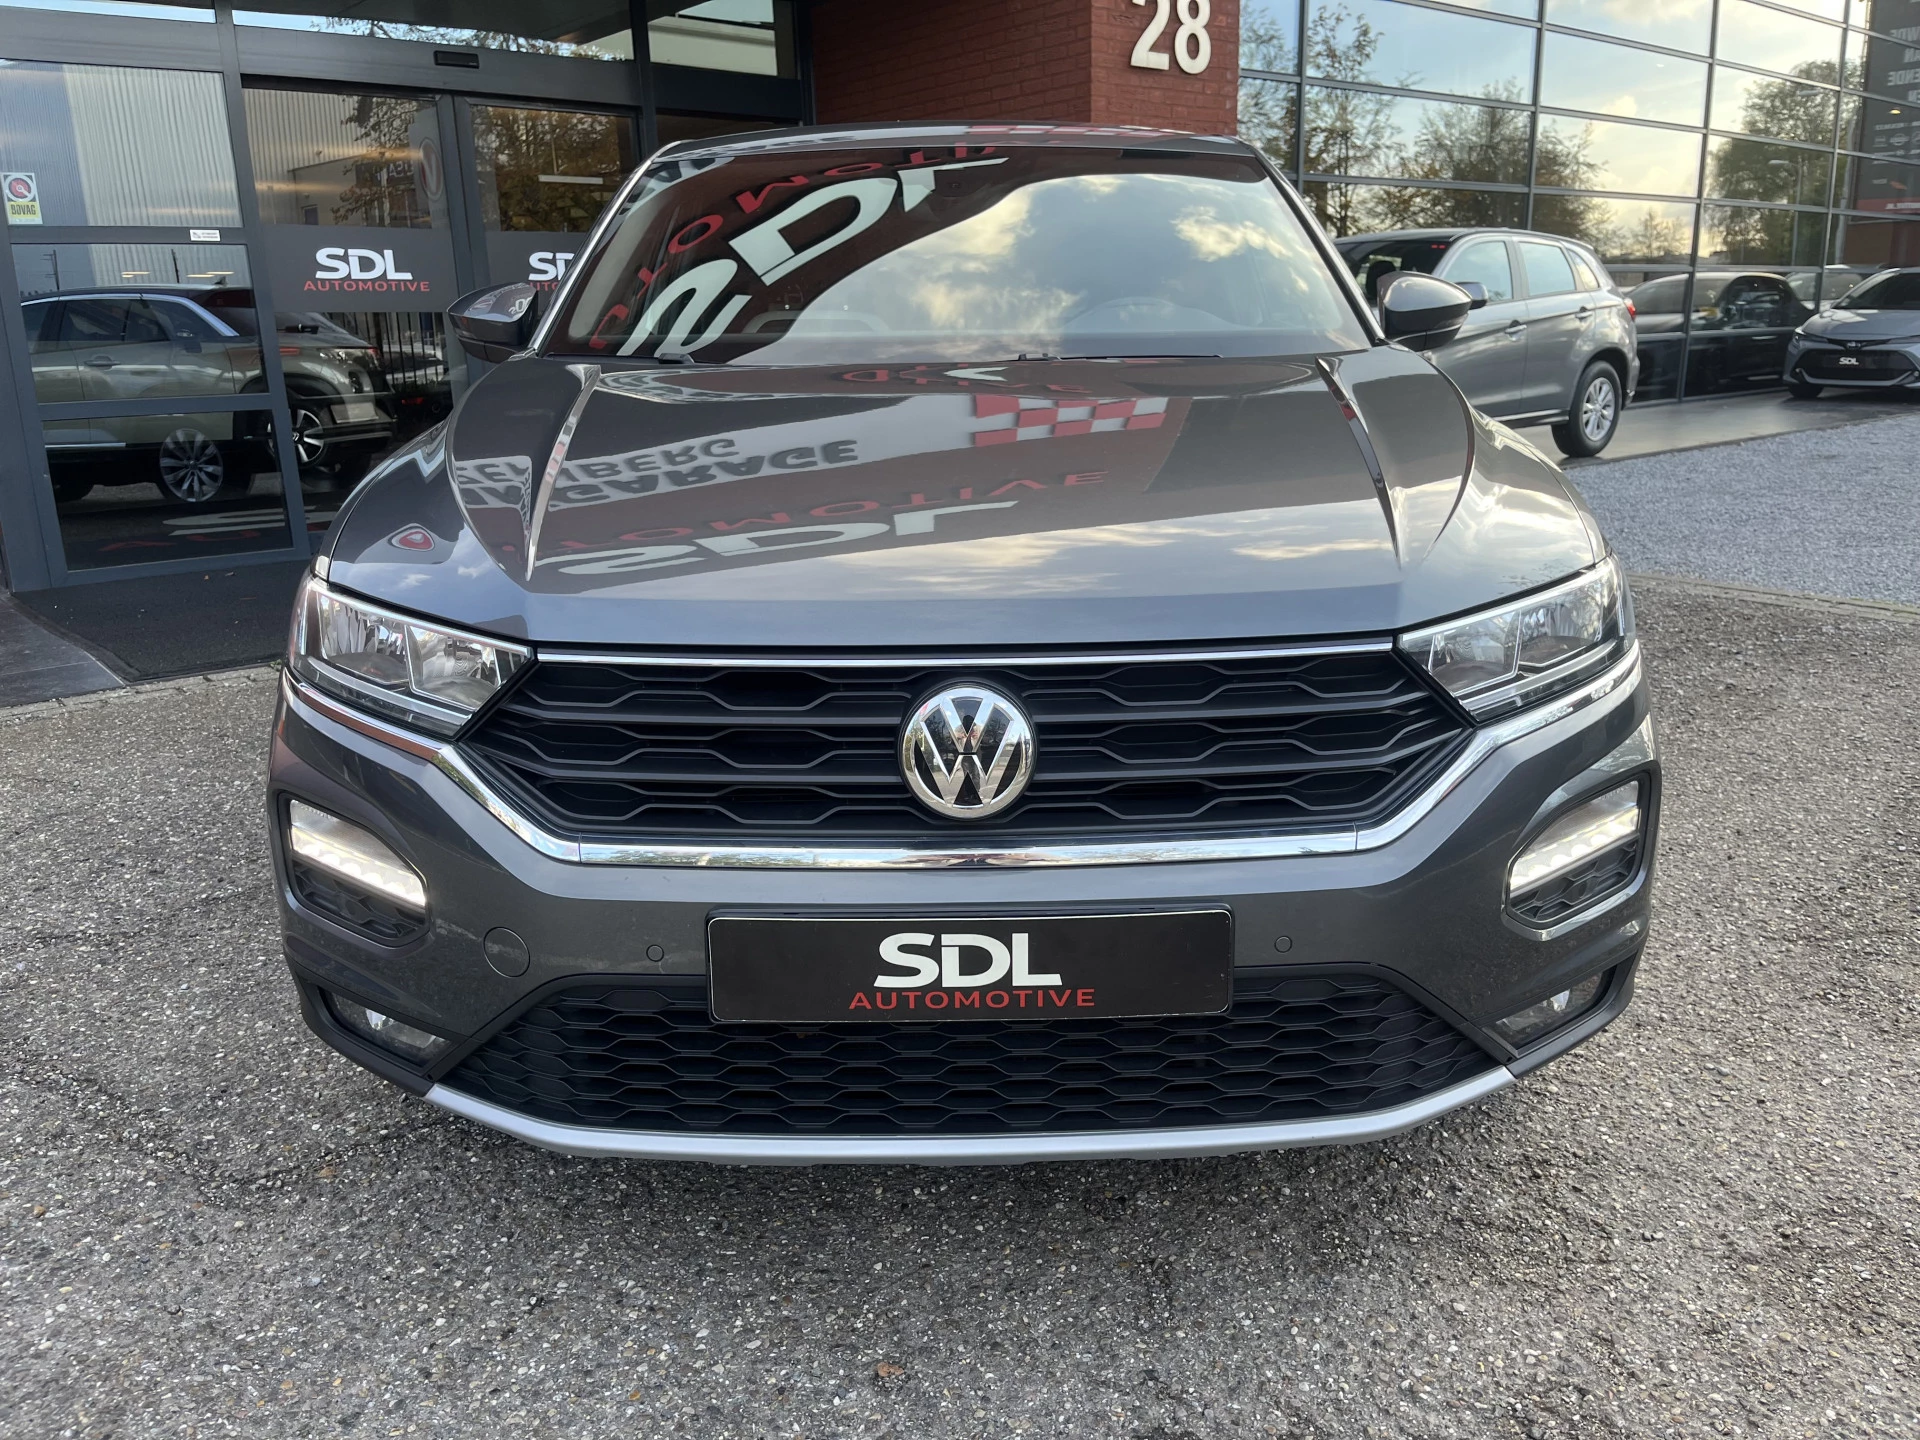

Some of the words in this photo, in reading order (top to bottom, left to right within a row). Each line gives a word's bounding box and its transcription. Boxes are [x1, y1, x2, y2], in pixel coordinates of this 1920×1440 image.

[1130, 0, 1211, 74] 28
[10, 204, 37, 216] BOVAG
[315, 247, 413, 280] SDL
[303, 280, 430, 292] AUTOMOTIVE
[1839, 357, 1859, 365] SDL
[874, 932, 1063, 988] SDL
[849, 988, 1095, 1010] AUTOMOTIVE
